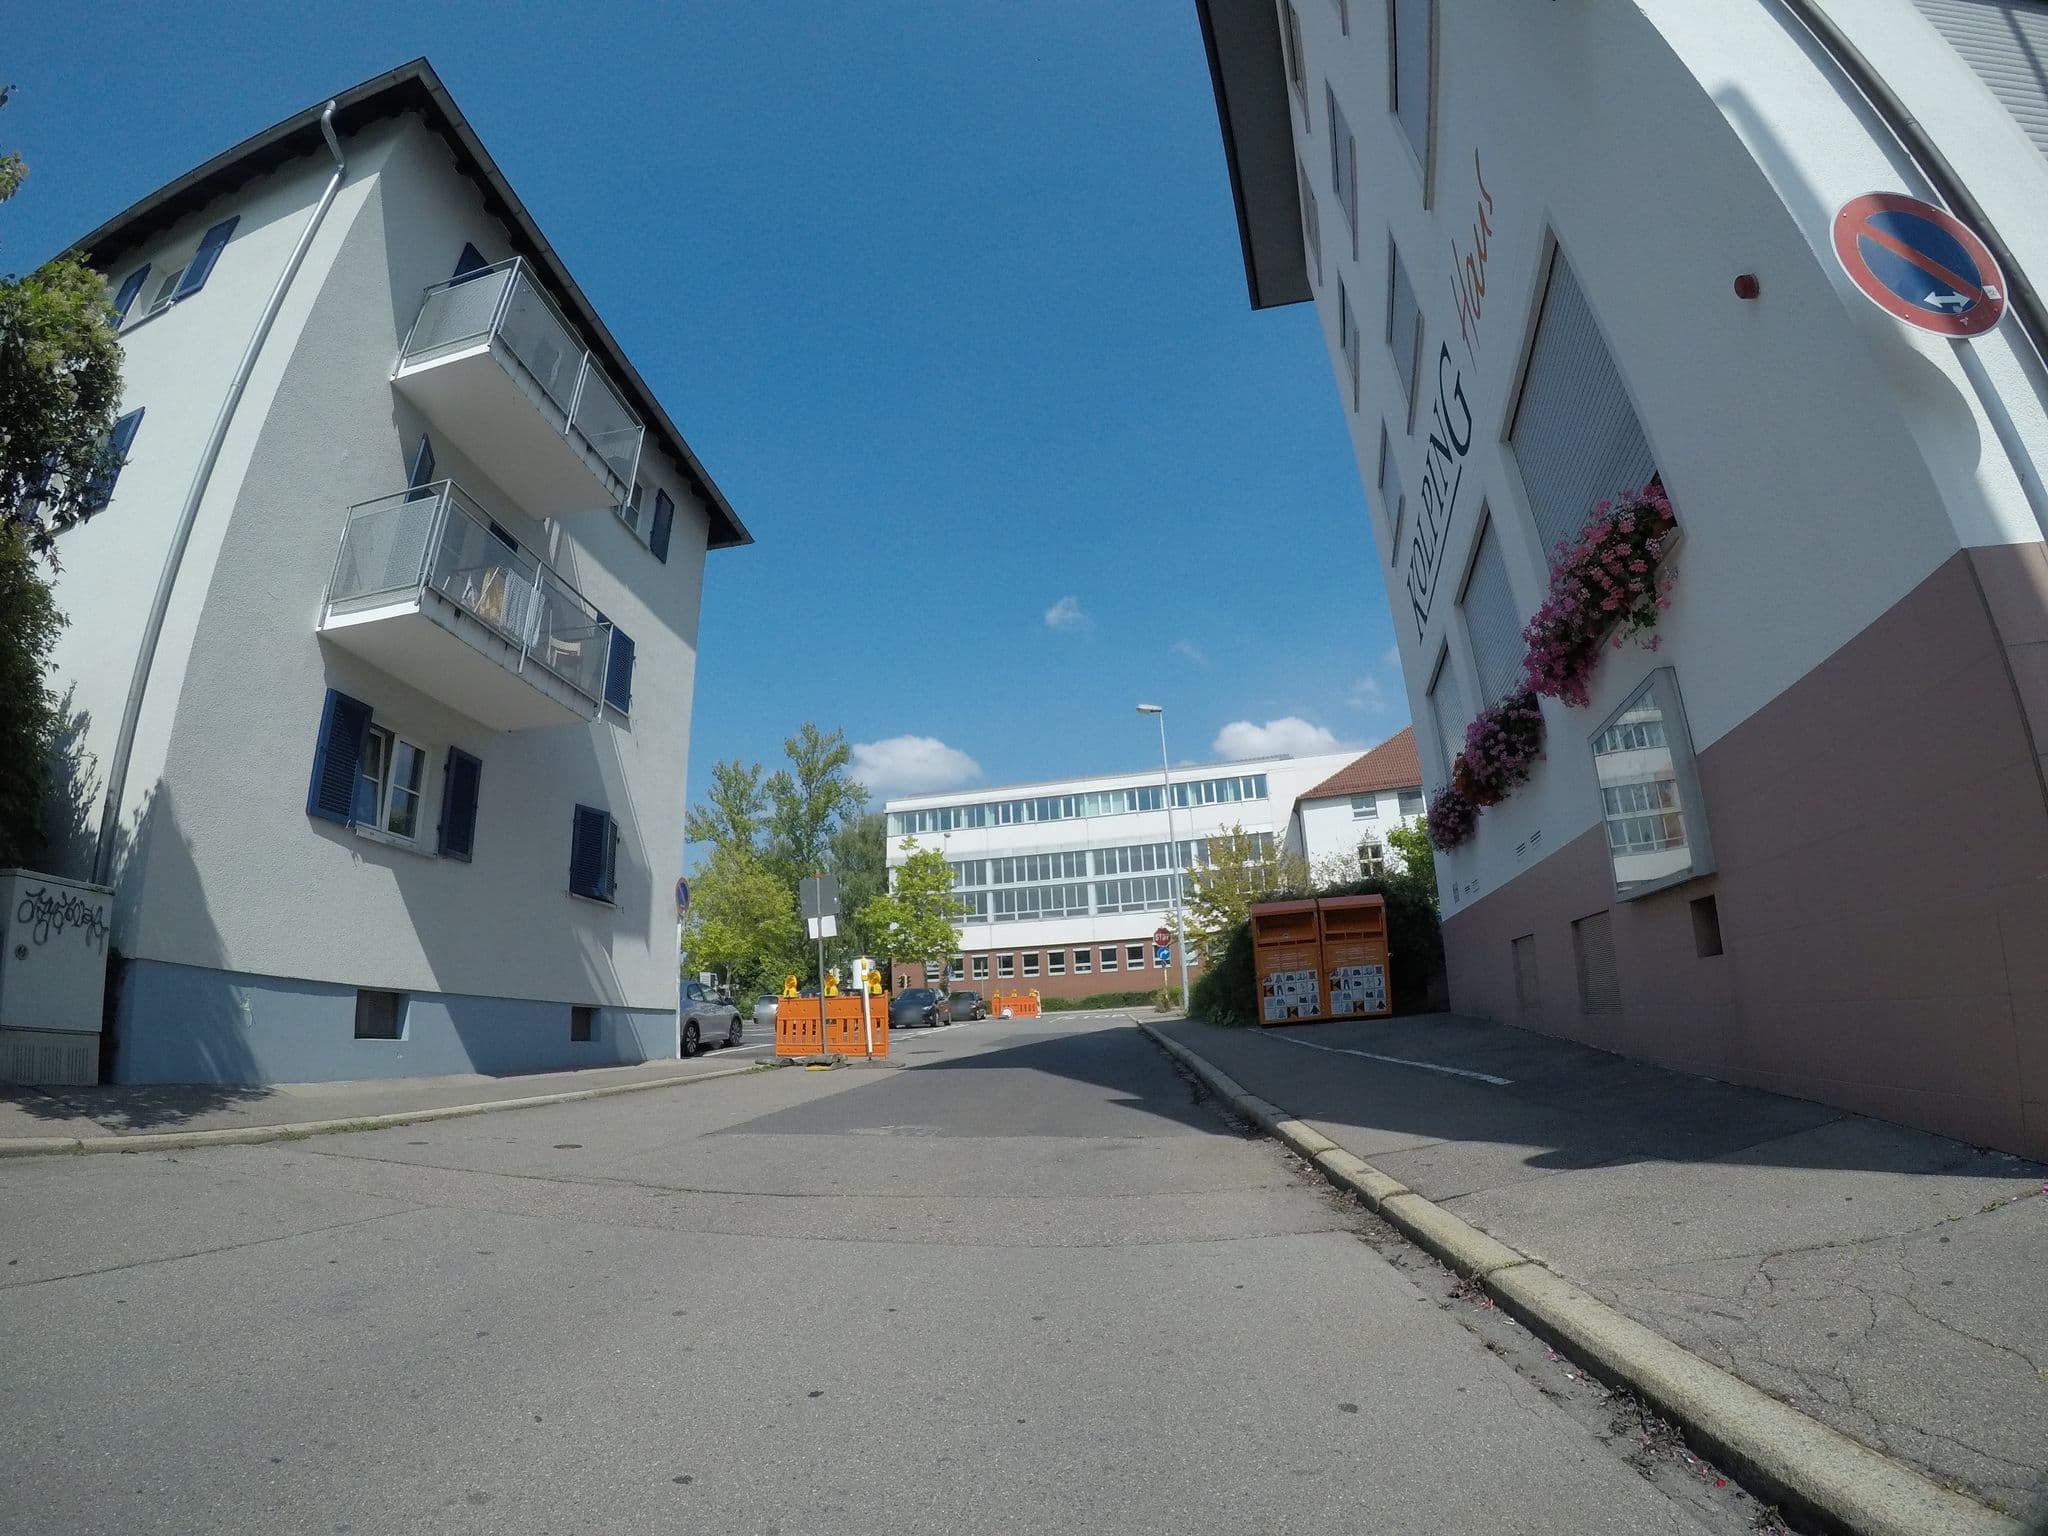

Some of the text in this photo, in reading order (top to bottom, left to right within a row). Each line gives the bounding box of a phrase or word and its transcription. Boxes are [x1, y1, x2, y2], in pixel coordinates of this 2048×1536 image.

[1406, 147, 1493, 644] KOLPING Haus
[1155, 933, 1170, 942] STOP
